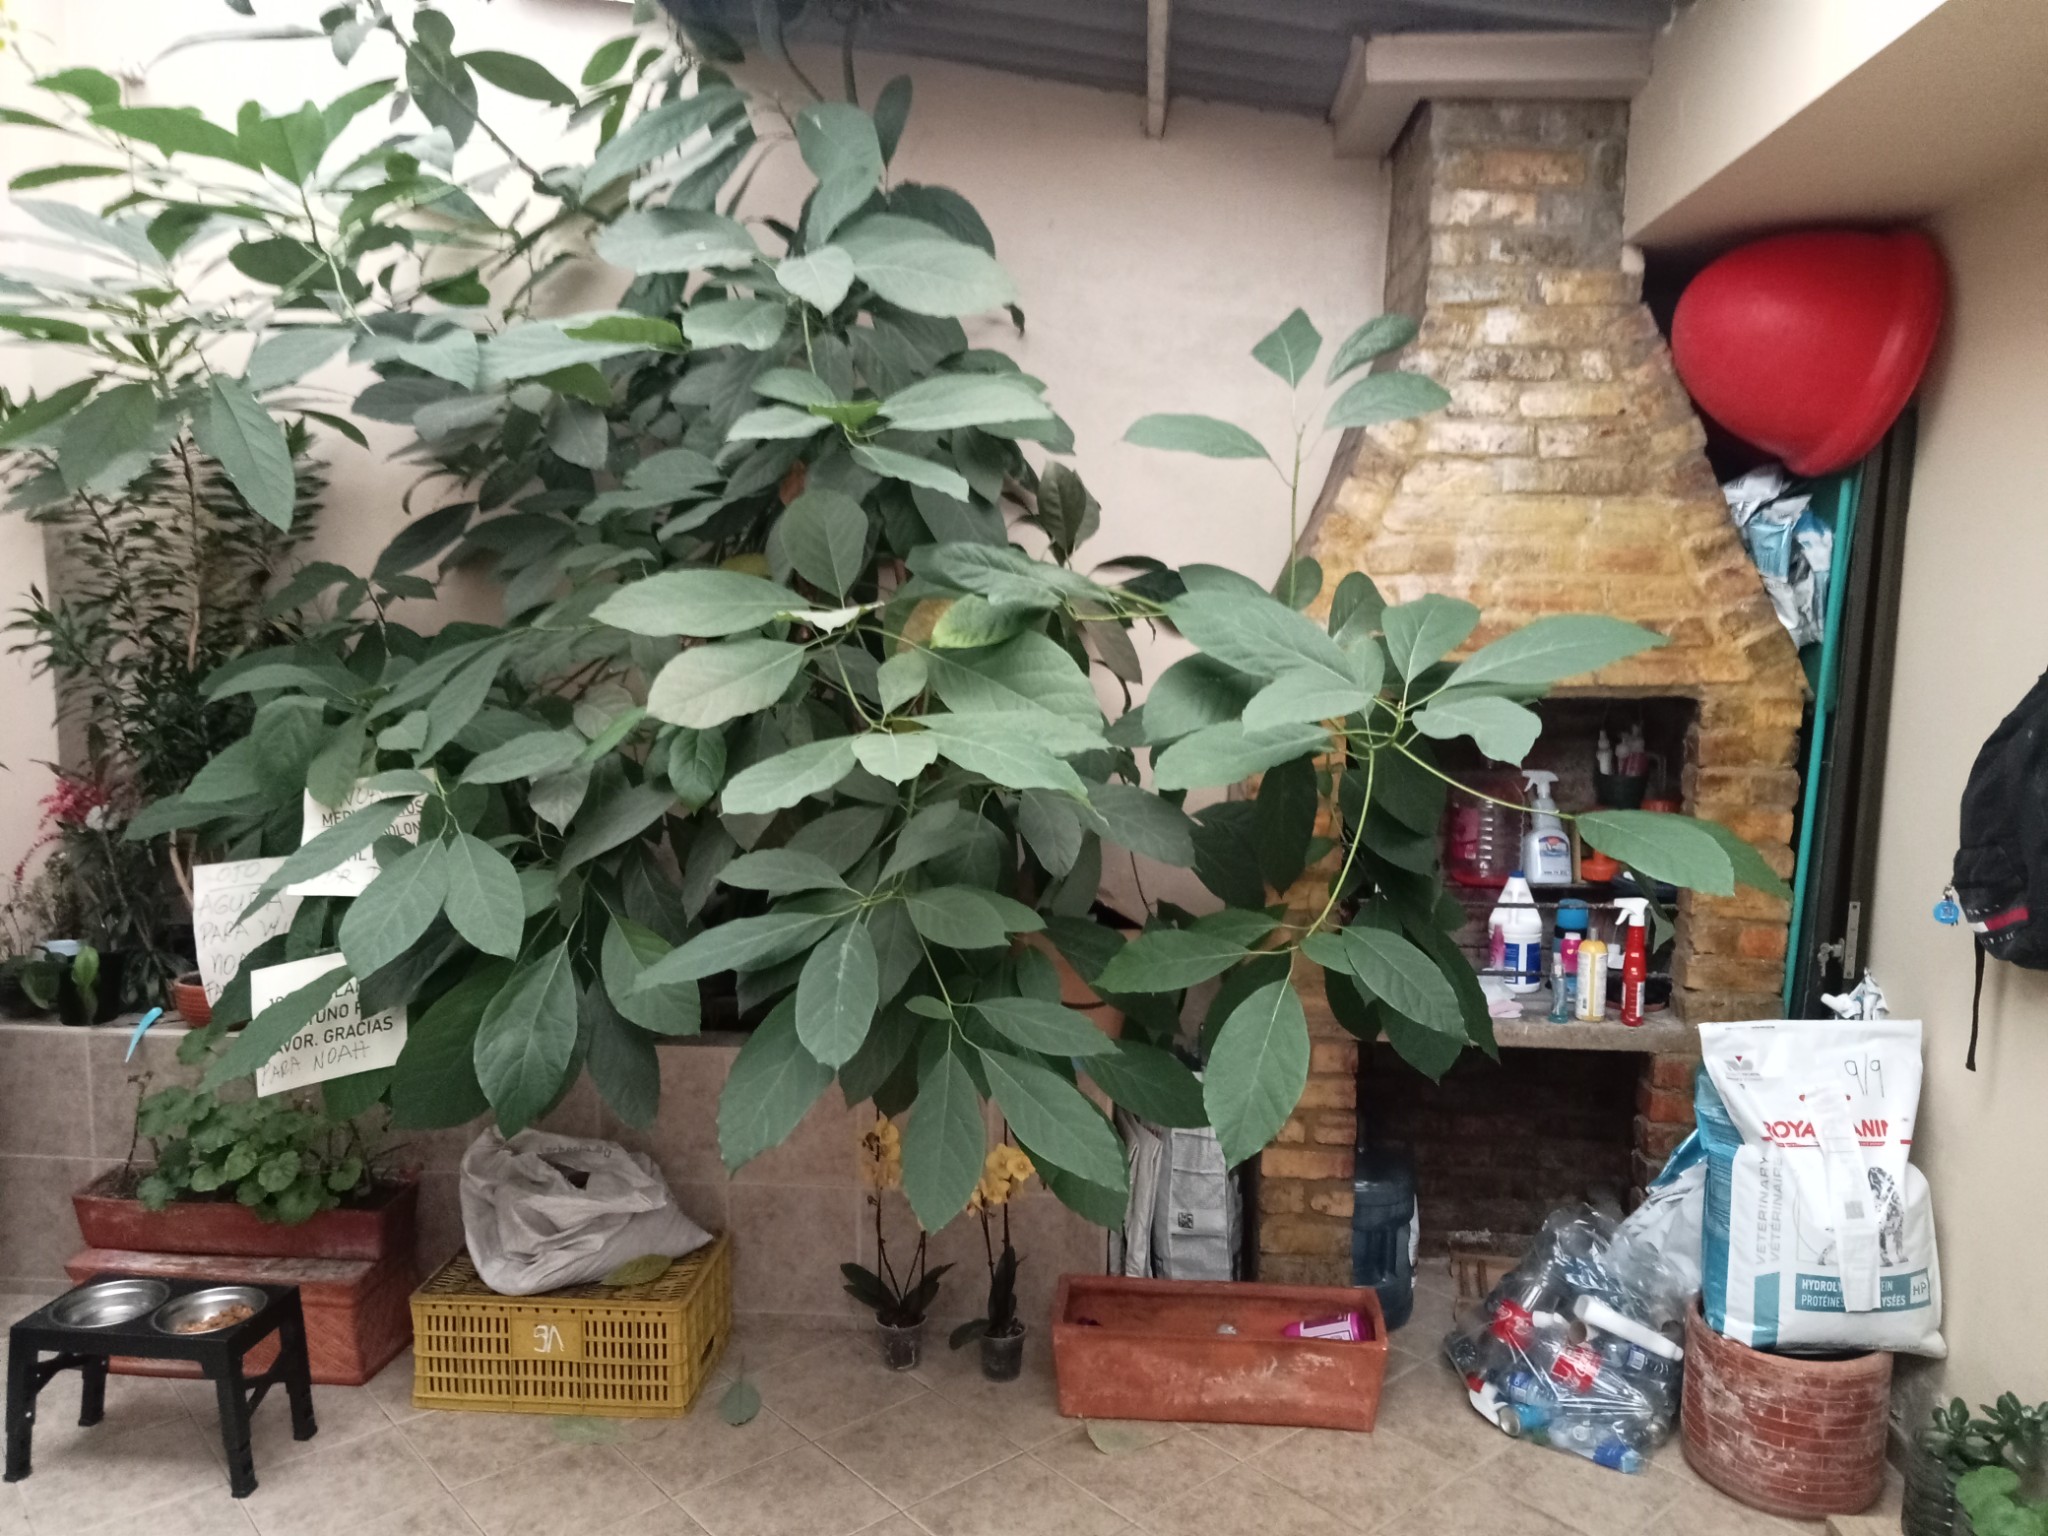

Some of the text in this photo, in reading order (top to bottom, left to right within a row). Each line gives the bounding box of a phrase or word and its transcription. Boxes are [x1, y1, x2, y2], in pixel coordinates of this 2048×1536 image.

[323, 1015, 394, 1044] GRACIAS
[313, 1041, 371, 1072] NOAH
[1912, 1281, 1927, 1296] HP
